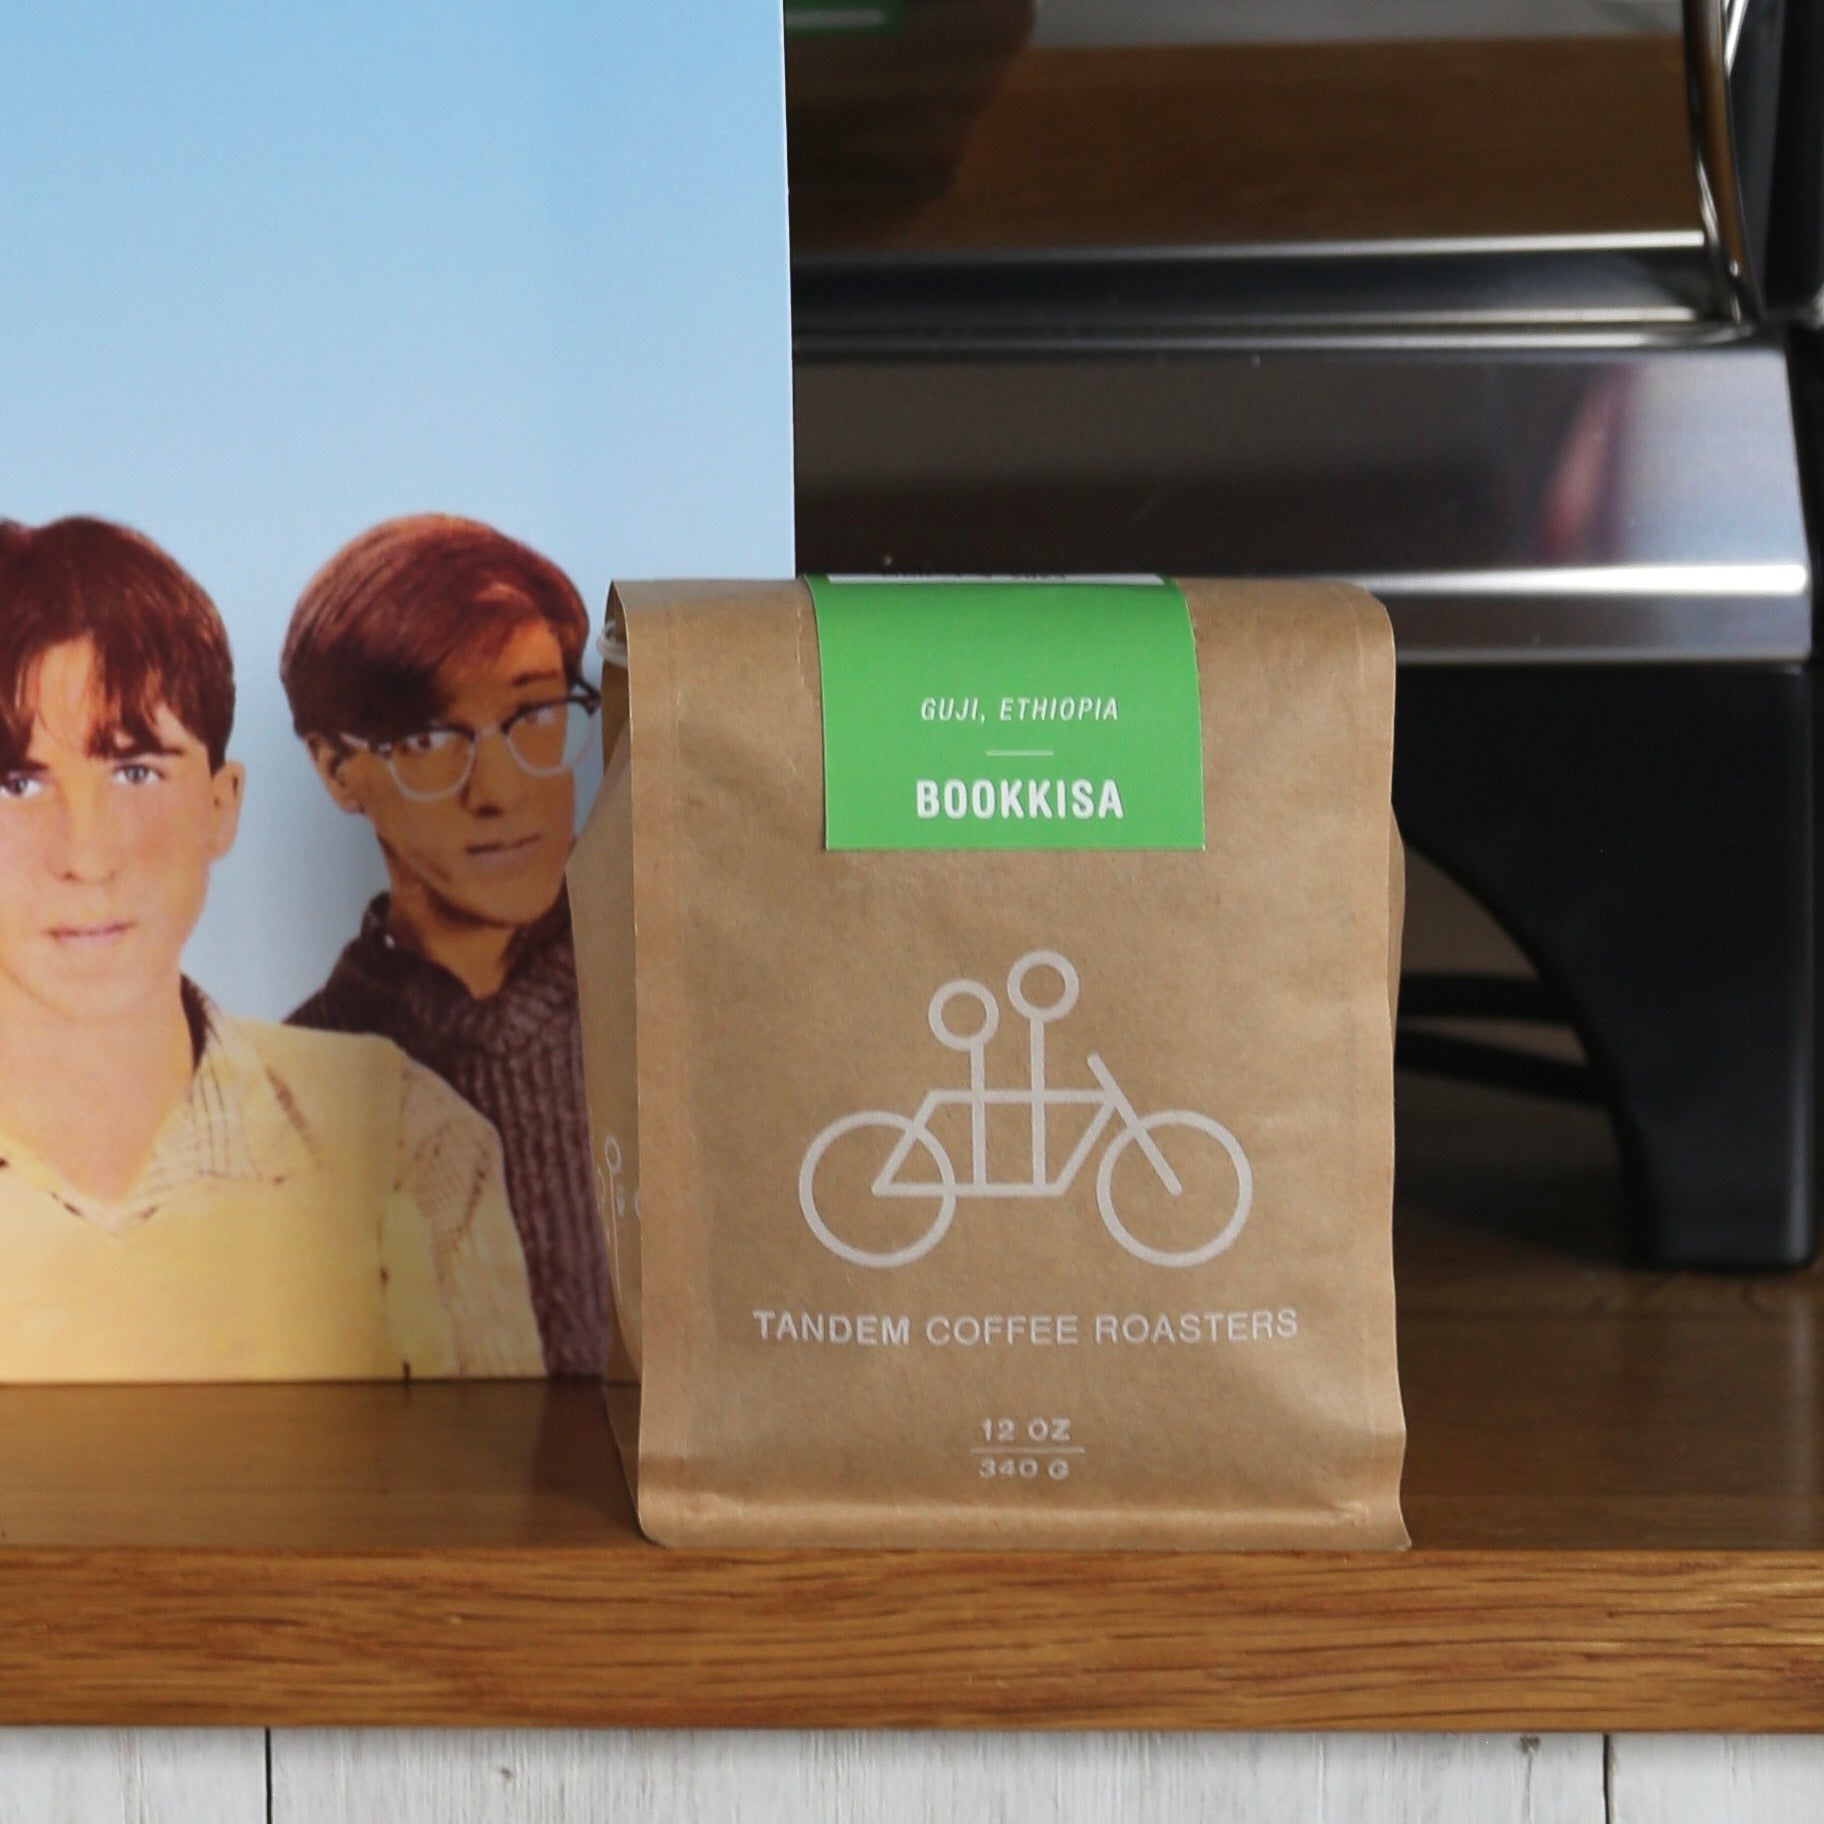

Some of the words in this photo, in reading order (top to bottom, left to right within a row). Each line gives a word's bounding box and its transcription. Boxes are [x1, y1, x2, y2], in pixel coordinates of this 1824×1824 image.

[919, 695, 987, 726] GUJI,
[998, 694, 1120, 723] ETHIOPIA
[914, 777, 1125, 820] BOOKKISA
[751, 1308, 911, 1347] TANDEM
[924, 1313, 1079, 1347] COFFEE
[1094, 1306, 1300, 1345] ROASTERS
[980, 1416, 1016, 1443] 12
[1026, 1416, 1072, 1443] OZ
[977, 1456, 1040, 1481] 340
[1047, 1456, 1070, 1481] G
